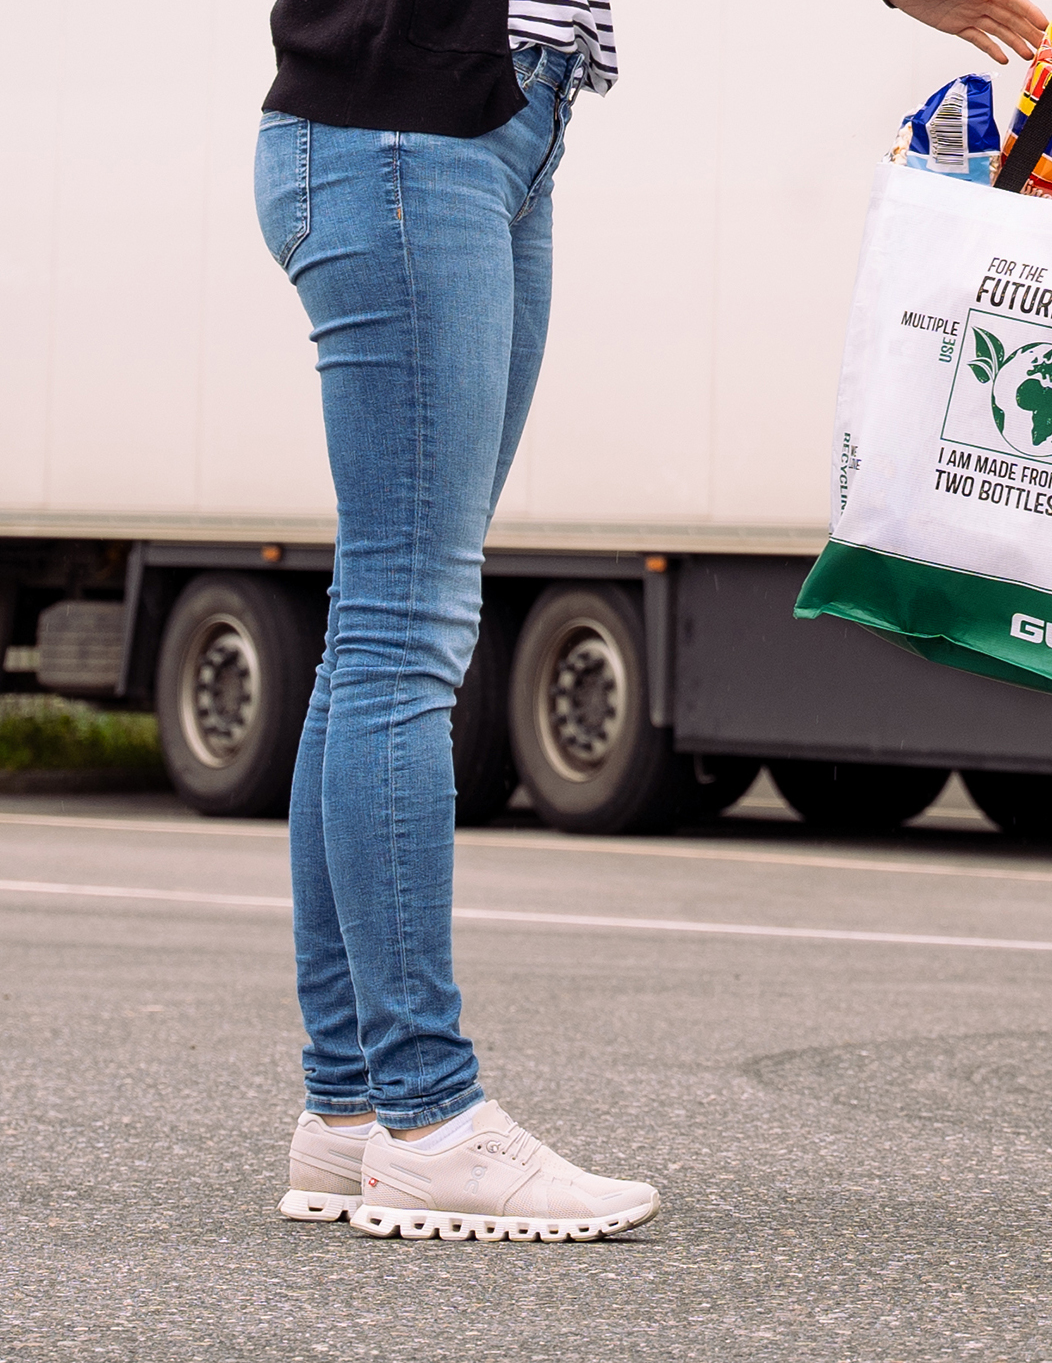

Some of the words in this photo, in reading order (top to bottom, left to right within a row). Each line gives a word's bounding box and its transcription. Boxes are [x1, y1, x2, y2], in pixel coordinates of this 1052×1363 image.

[988, 257, 1017, 277] FOR
[1019, 263, 1048, 283] THE
[900, 310, 960, 337] MULTIPLE
[938, 337, 957, 363] USE
[938, 447, 945, 464] I
[946, 449, 972, 470] AM
[974, 455, 1018, 480] MADE
[935, 469, 975, 497] TWO
